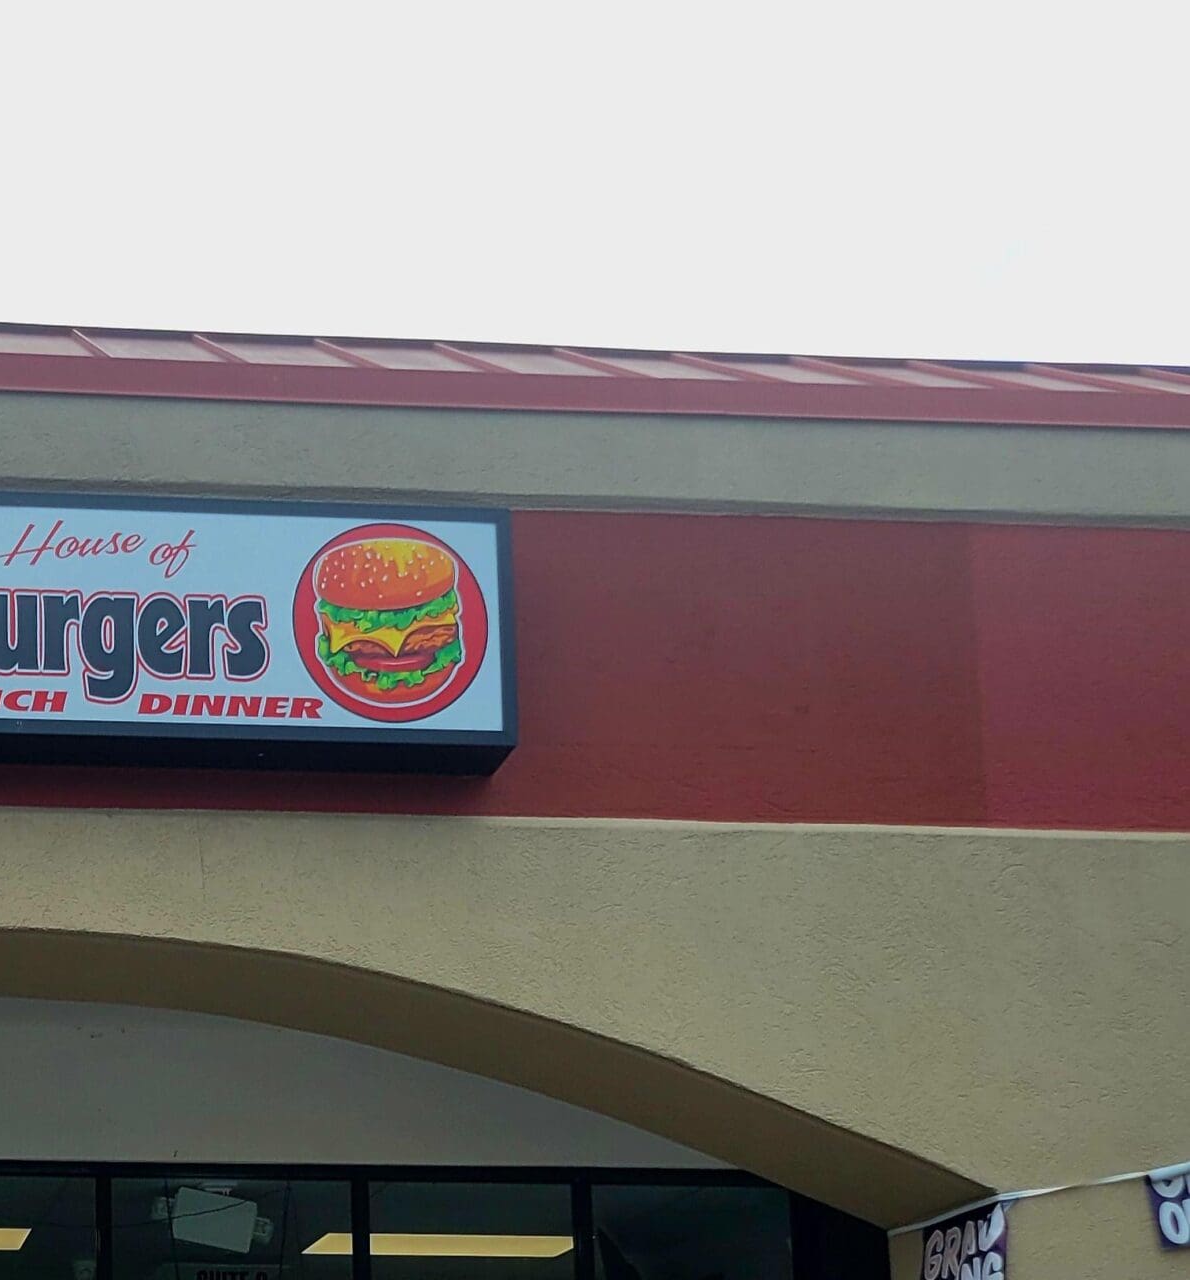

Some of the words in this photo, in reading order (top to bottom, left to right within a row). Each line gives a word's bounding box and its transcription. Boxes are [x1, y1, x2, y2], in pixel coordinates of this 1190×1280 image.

[0, 519, 145, 567] House
[149, 531, 199, 575] of
[137, 692, 323, 719] DINNER
